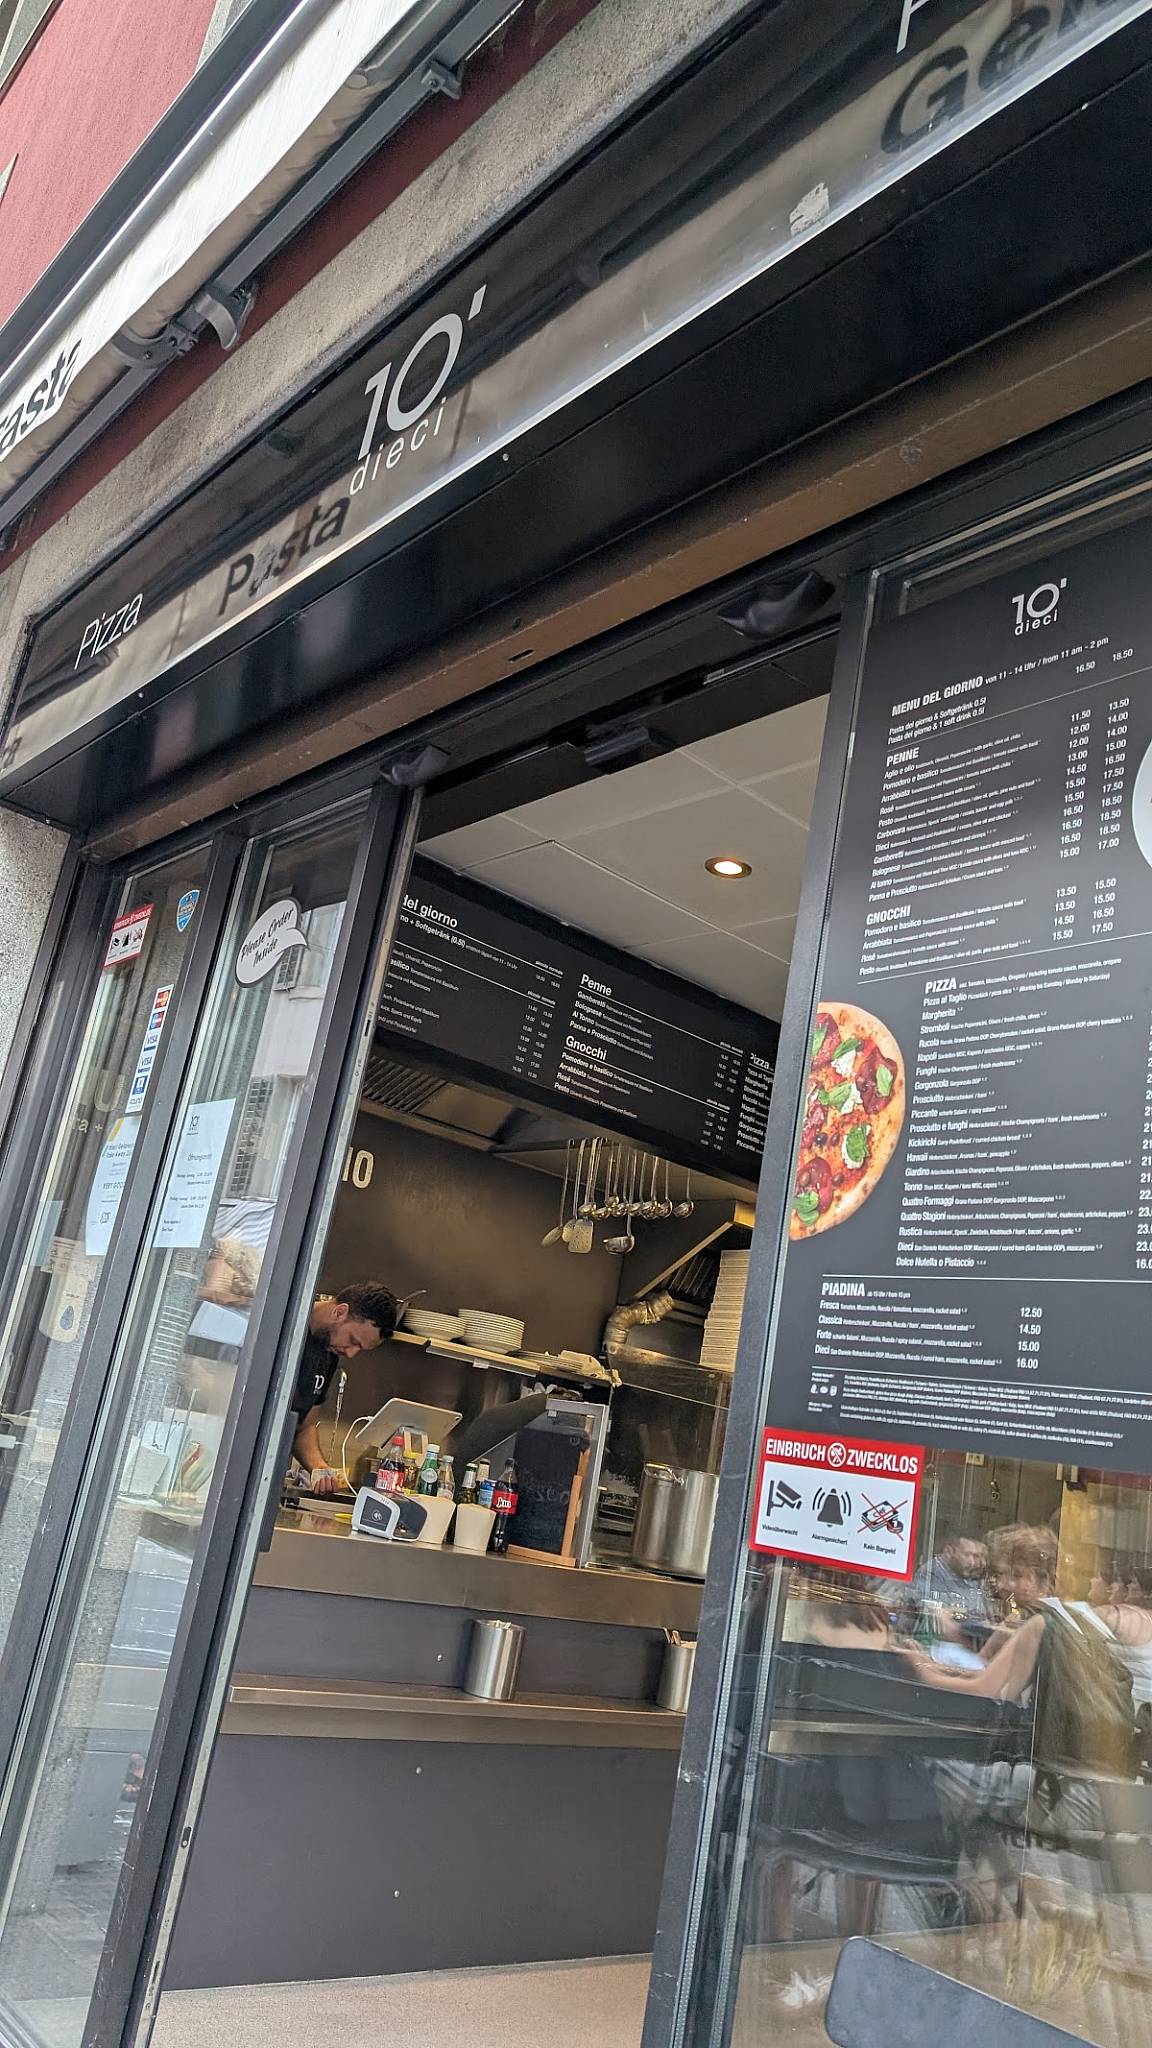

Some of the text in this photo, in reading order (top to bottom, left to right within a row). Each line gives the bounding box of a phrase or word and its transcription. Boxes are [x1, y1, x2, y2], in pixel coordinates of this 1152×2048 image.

[358, 284, 487, 461] 10'
[350, 396, 447, 496] dieci
[218, 497, 350, 616] Pasta
[1012, 577, 1067, 625] 10'
[1014, 609, 1058, 636] dieci
[73, 592, 144, 671] Pizza
[1076, 648, 1133, 673] 16.50 18.50
[891, 697, 921, 716] MENU
[922, 691, 941, 706] DEL
[943, 676, 983, 698] GIORNO
[985, 675, 997, 684] von
[999, 671, 1006, 679] 11
[1015, 665, 1022, 674] 14
[1024, 662, 1036, 671] Uhr
[1042, 654, 1059, 664] from
[1061, 650, 1069, 658] 11
[1071, 646, 1083, 655] am
[1090, 640, 1095, 649] 2
[1096, 637, 1109, 648] pm
[1071, 698, 1129, 722] 11.50 13.50
[889, 725, 904, 735] Pasta
[905, 720, 914, 730] del
[915, 716, 933, 728] giorno
[933, 712, 938, 720] &
[939, 702, 973, 718] Softgetränk
[1070, 711, 1128, 735] 12.00 14.00
[887, 735, 903, 745] Pasta
[904, 730, 913, 739] del
[914, 725, 932, 738] giorno
[932, 722, 937, 730] &
[943, 716, 955, 726] soft
[956, 712, 971, 722] drink
[1069, 725, 1127, 748] 12.00 14.00
[886, 747, 919, 767] PENNE
[1068, 739, 1126, 762] 13.00 15.00
[1067, 753, 1125, 775] 14.50 16.50
[884, 769, 899, 779] Aglio
[904, 764, 915, 773] olio
[1066, 767, 1124, 789] 15.50 17.50
[882, 777, 911, 791] Pomodoro
[916, 769, 939, 781] basilico
[881, 789, 910, 803] Arrabbiata
[1064, 780, 1123, 803] 15.50 17.50
[879, 804, 894, 815] Rosé
[1063, 795, 1122, 816] 16.50 18.50
[878, 818, 893, 827] Pesto
[1062, 809, 1121, 830] 16.50 18.50
[876, 826, 905, 839] Carbonara
[1061, 823, 1120, 844] 16.50 18.50
[875, 841, 890, 852] Dieci
[1060, 837, 1119, 858] 15.00 17.00
[873, 851, 903, 864] Gamberetti
[872, 864, 901, 877] Bolognese
[870, 879, 892, 889] Al tonno
[1056, 878, 1116, 898] 13.50 15.50
[868, 892, 885, 902] Panna
[890, 885, 918, 897] Prosciutto
[1055, 892, 1115, 912] 13.50 15.50
[419, 905, 457, 928] giorno
[866, 904, 911, 925] GNOCCHI
[1054, 907, 1114, 926] 14.50 16.50
[240, 908, 294, 962] Please Order
[415, 920, 450, 941] Softgetränk
[864, 925, 893, 937] Pomodoro
[899, 919, 921, 930] basilico
[1053, 922, 1113, 941] 15.50 17.50
[862, 938, 892, 950] Arrabbiata
[253, 939, 278, 968] Inside
[861, 953, 876, 962] Rosé
[859, 966, 875, 975] Pesto
[581, 974, 612, 996] Penne
[925, 977, 957, 994] PIZZA
[923, 993, 967, 1006] Pizza al Taglio
[922, 1008, 956, 1020] Margherita
[920, 1022, 950, 1034] Stromboli
[566, 1035, 607, 1060] Gnocchi
[918, 1038, 939, 1048] Rucola
[917, 1051, 937, 1062] Napoli
[915, 1066, 937, 1076] Funghi
[914, 1079, 949, 1091] Gorgonzola
[912, 1094, 944, 1104] Prosciutto
[911, 1108, 938, 1118] Piccante
[909, 1120, 968, 1133] Prosciutto e funghi
[908, 1137, 937, 1147] Kickiricki
[906, 1152, 928, 1162] Hawaii
[905, 1167, 930, 1176] Giardino
[904, 1182, 923, 1191] Tonno
[902, 1196, 954, 1207] Quattro Formaggi
[900, 1211, 946, 1222] Quattro Stagioni
[899, 1227, 922, 1236] Rustica
[897, 1242, 914, 1251] Dieci
[896, 1257, 914, 1266] Dolce
[914, 1257, 938, 1266] Nutella
[944, 1257, 974, 1267] Pistaccio
[821, 1282, 865, 1296] PIADINA
[819, 1300, 839, 1309] Fresca
[818, 1314, 843, 1324] Classica
[1021, 1307, 1042, 1318] 12.50
[816, 1329, 832, 1339] Forte
[1019, 1324, 1041, 1335] 14.50
[815, 1344, 830, 1354] Dieci
[1018, 1341, 1040, 1352] 15.00
[1016, 1358, 1038, 1369] 16.00
[766, 1438, 918, 1475] EINBRUCH ZWECKLOS
